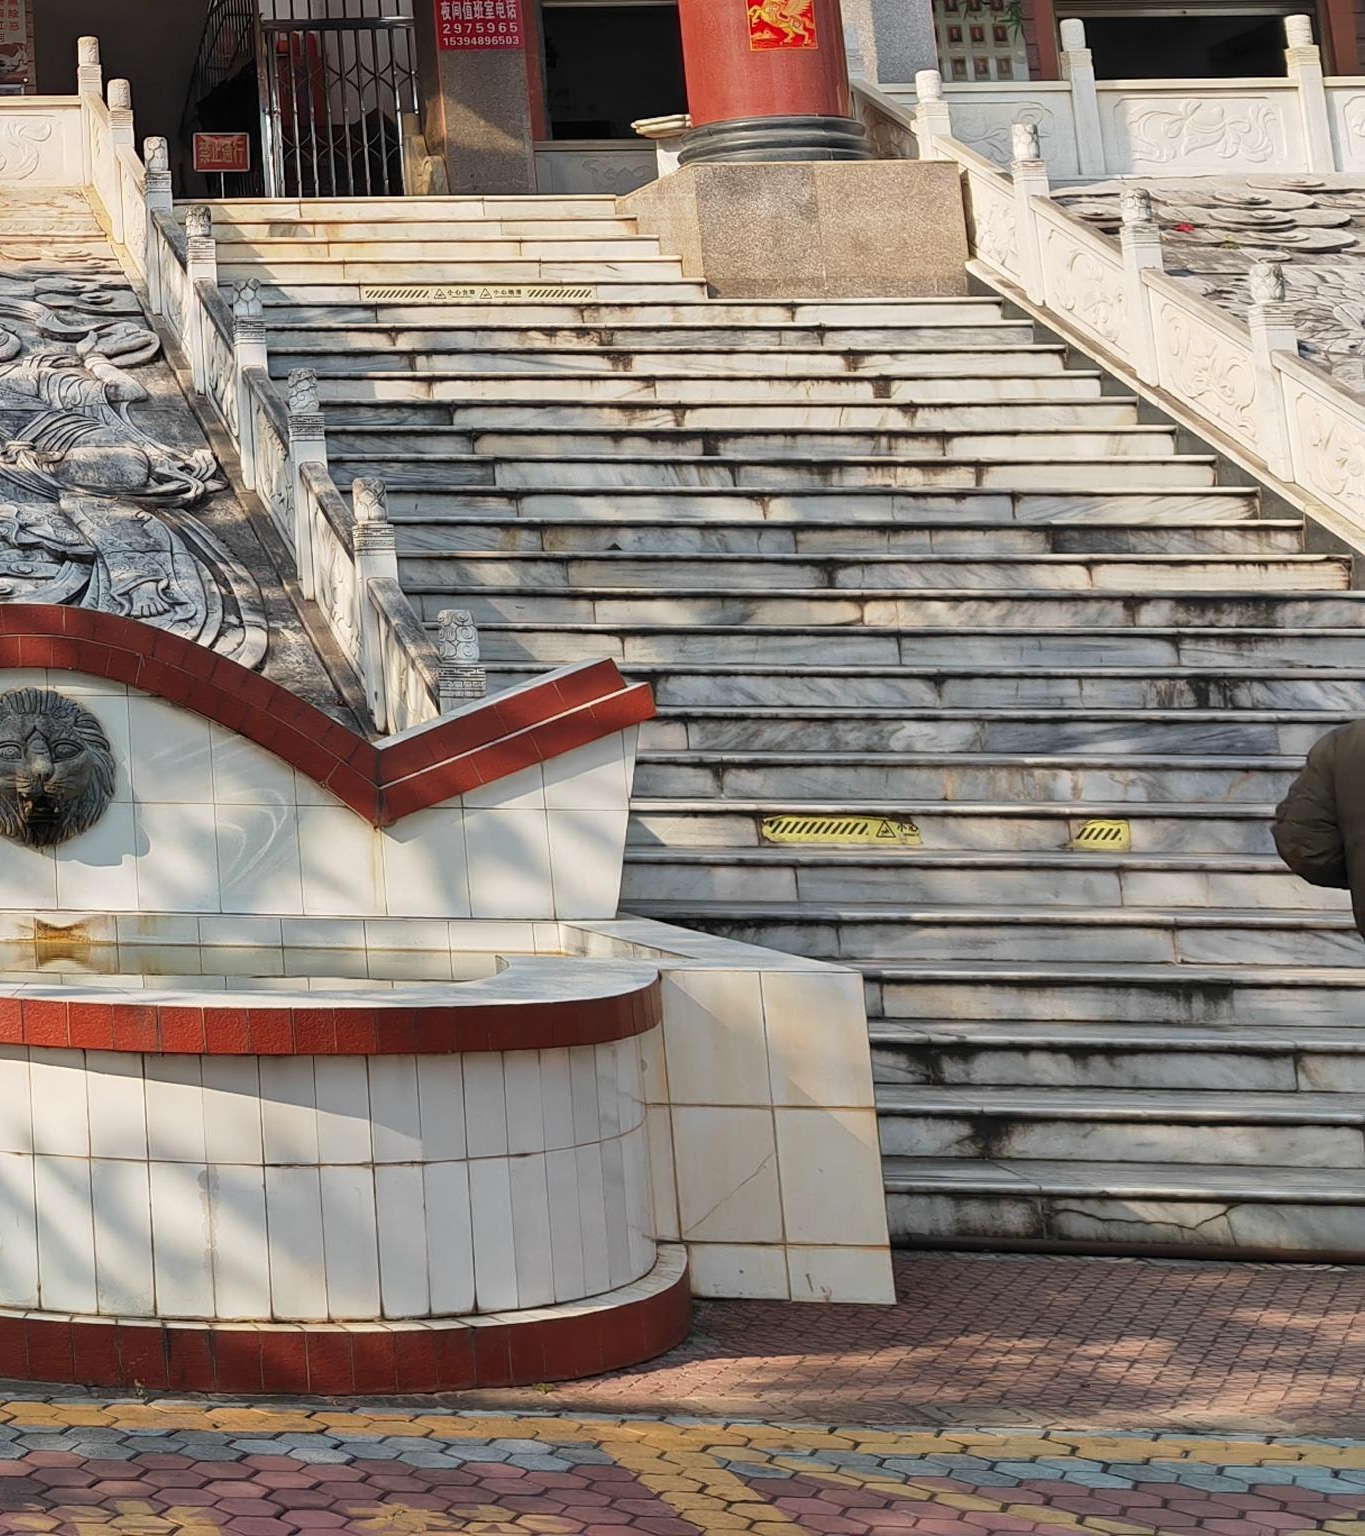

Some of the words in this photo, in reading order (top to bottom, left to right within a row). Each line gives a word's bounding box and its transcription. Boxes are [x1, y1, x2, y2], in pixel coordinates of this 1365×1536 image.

[440, 0, 517, 21] 夜间值班室电话
[443, 22, 518, 34] 2975965
[443, 36, 519, 46] 15394896503
